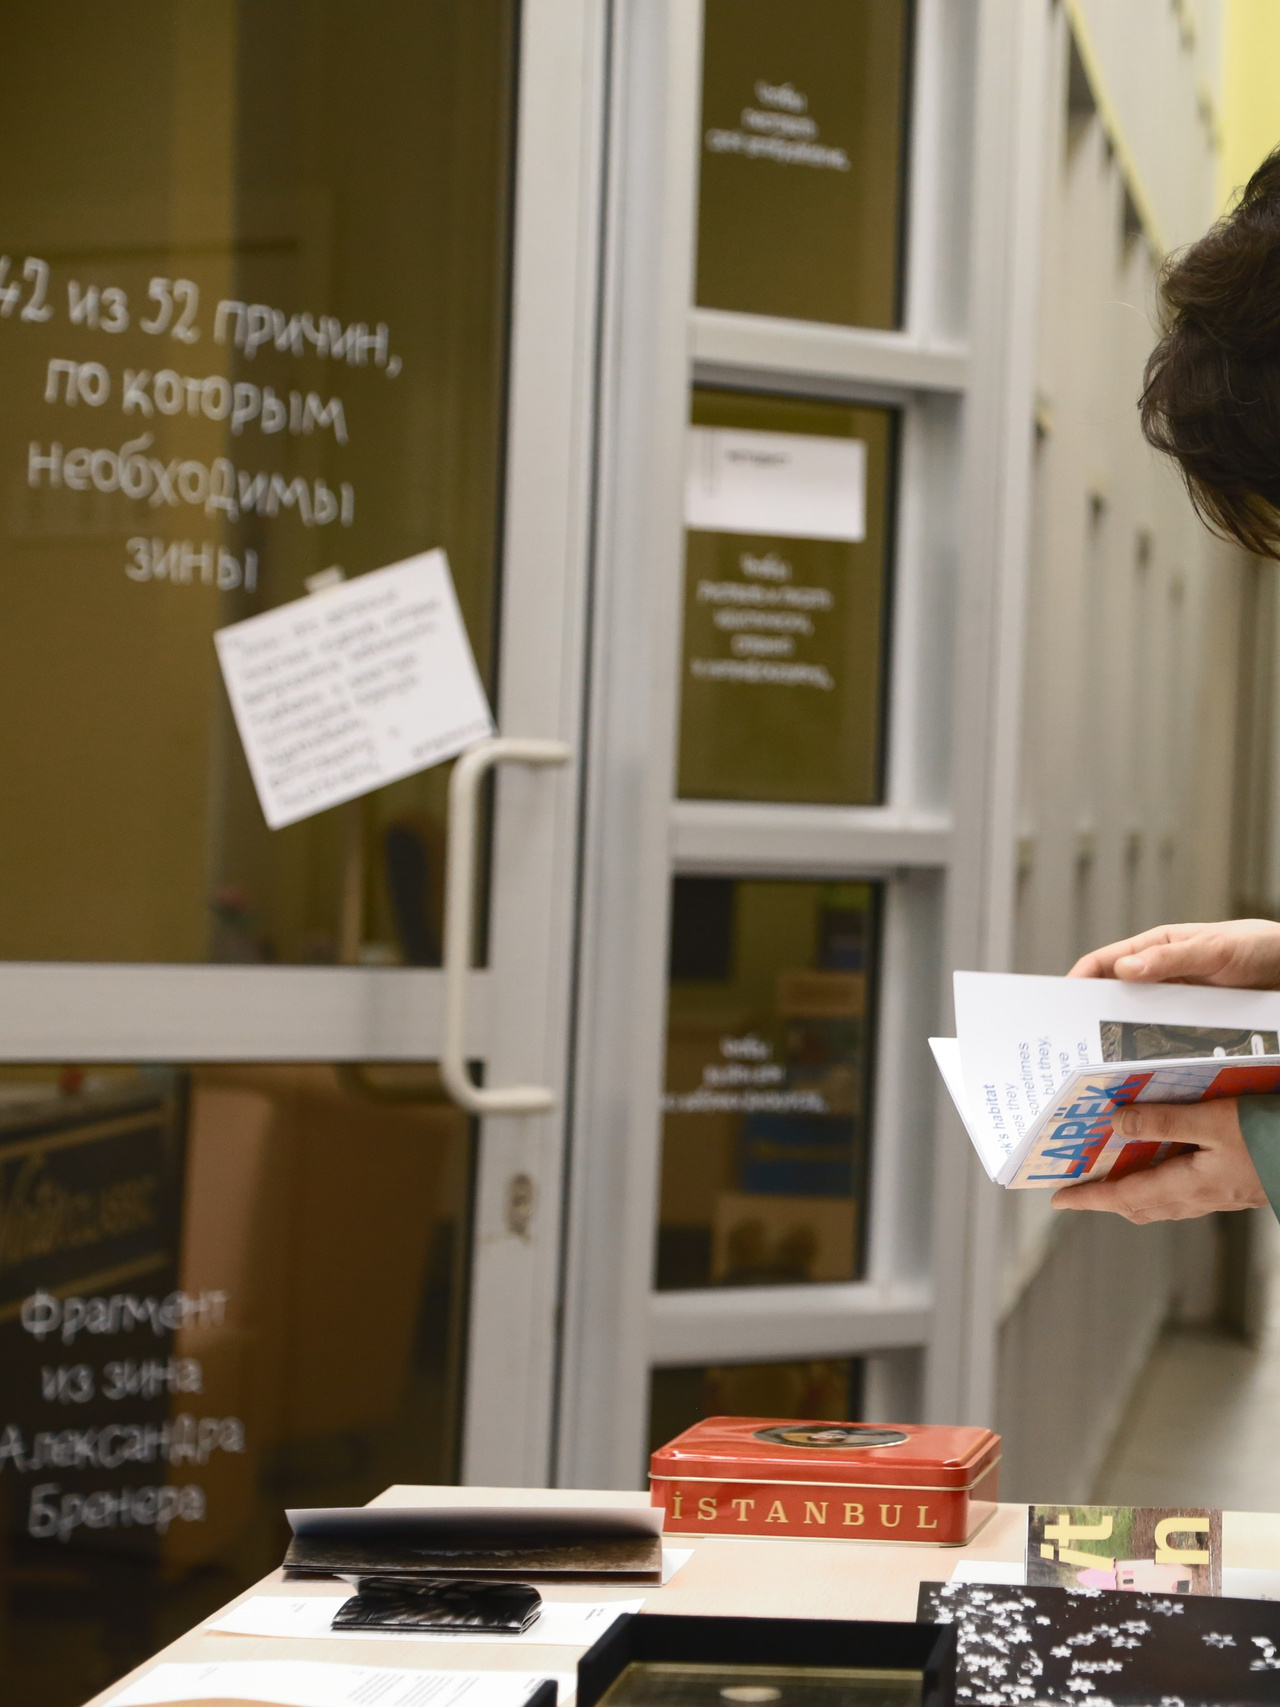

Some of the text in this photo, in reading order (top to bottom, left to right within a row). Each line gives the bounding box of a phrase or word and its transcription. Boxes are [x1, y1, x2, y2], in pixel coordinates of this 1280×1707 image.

[67, 278, 130, 334] из
[139, 276, 201, 344] 52
[213, 299, 403, 378] причин,
[44, 357, 349, 446] по которым
[27, 430, 355, 528] необходимы
[124, 536, 259, 594] зины
[1005, 1082, 1020, 1110] they
[1019, 1042, 1040, 1116] sometimes
[1043, 1074, 1056, 1095] but
[1059, 1052, 1070, 1081] ave
[983, 1084, 1014, 1159] ek's habitat
[1026, 1080, 1141, 1181] LARËK
[670, 1491, 939, 1530] İSTANBUL
